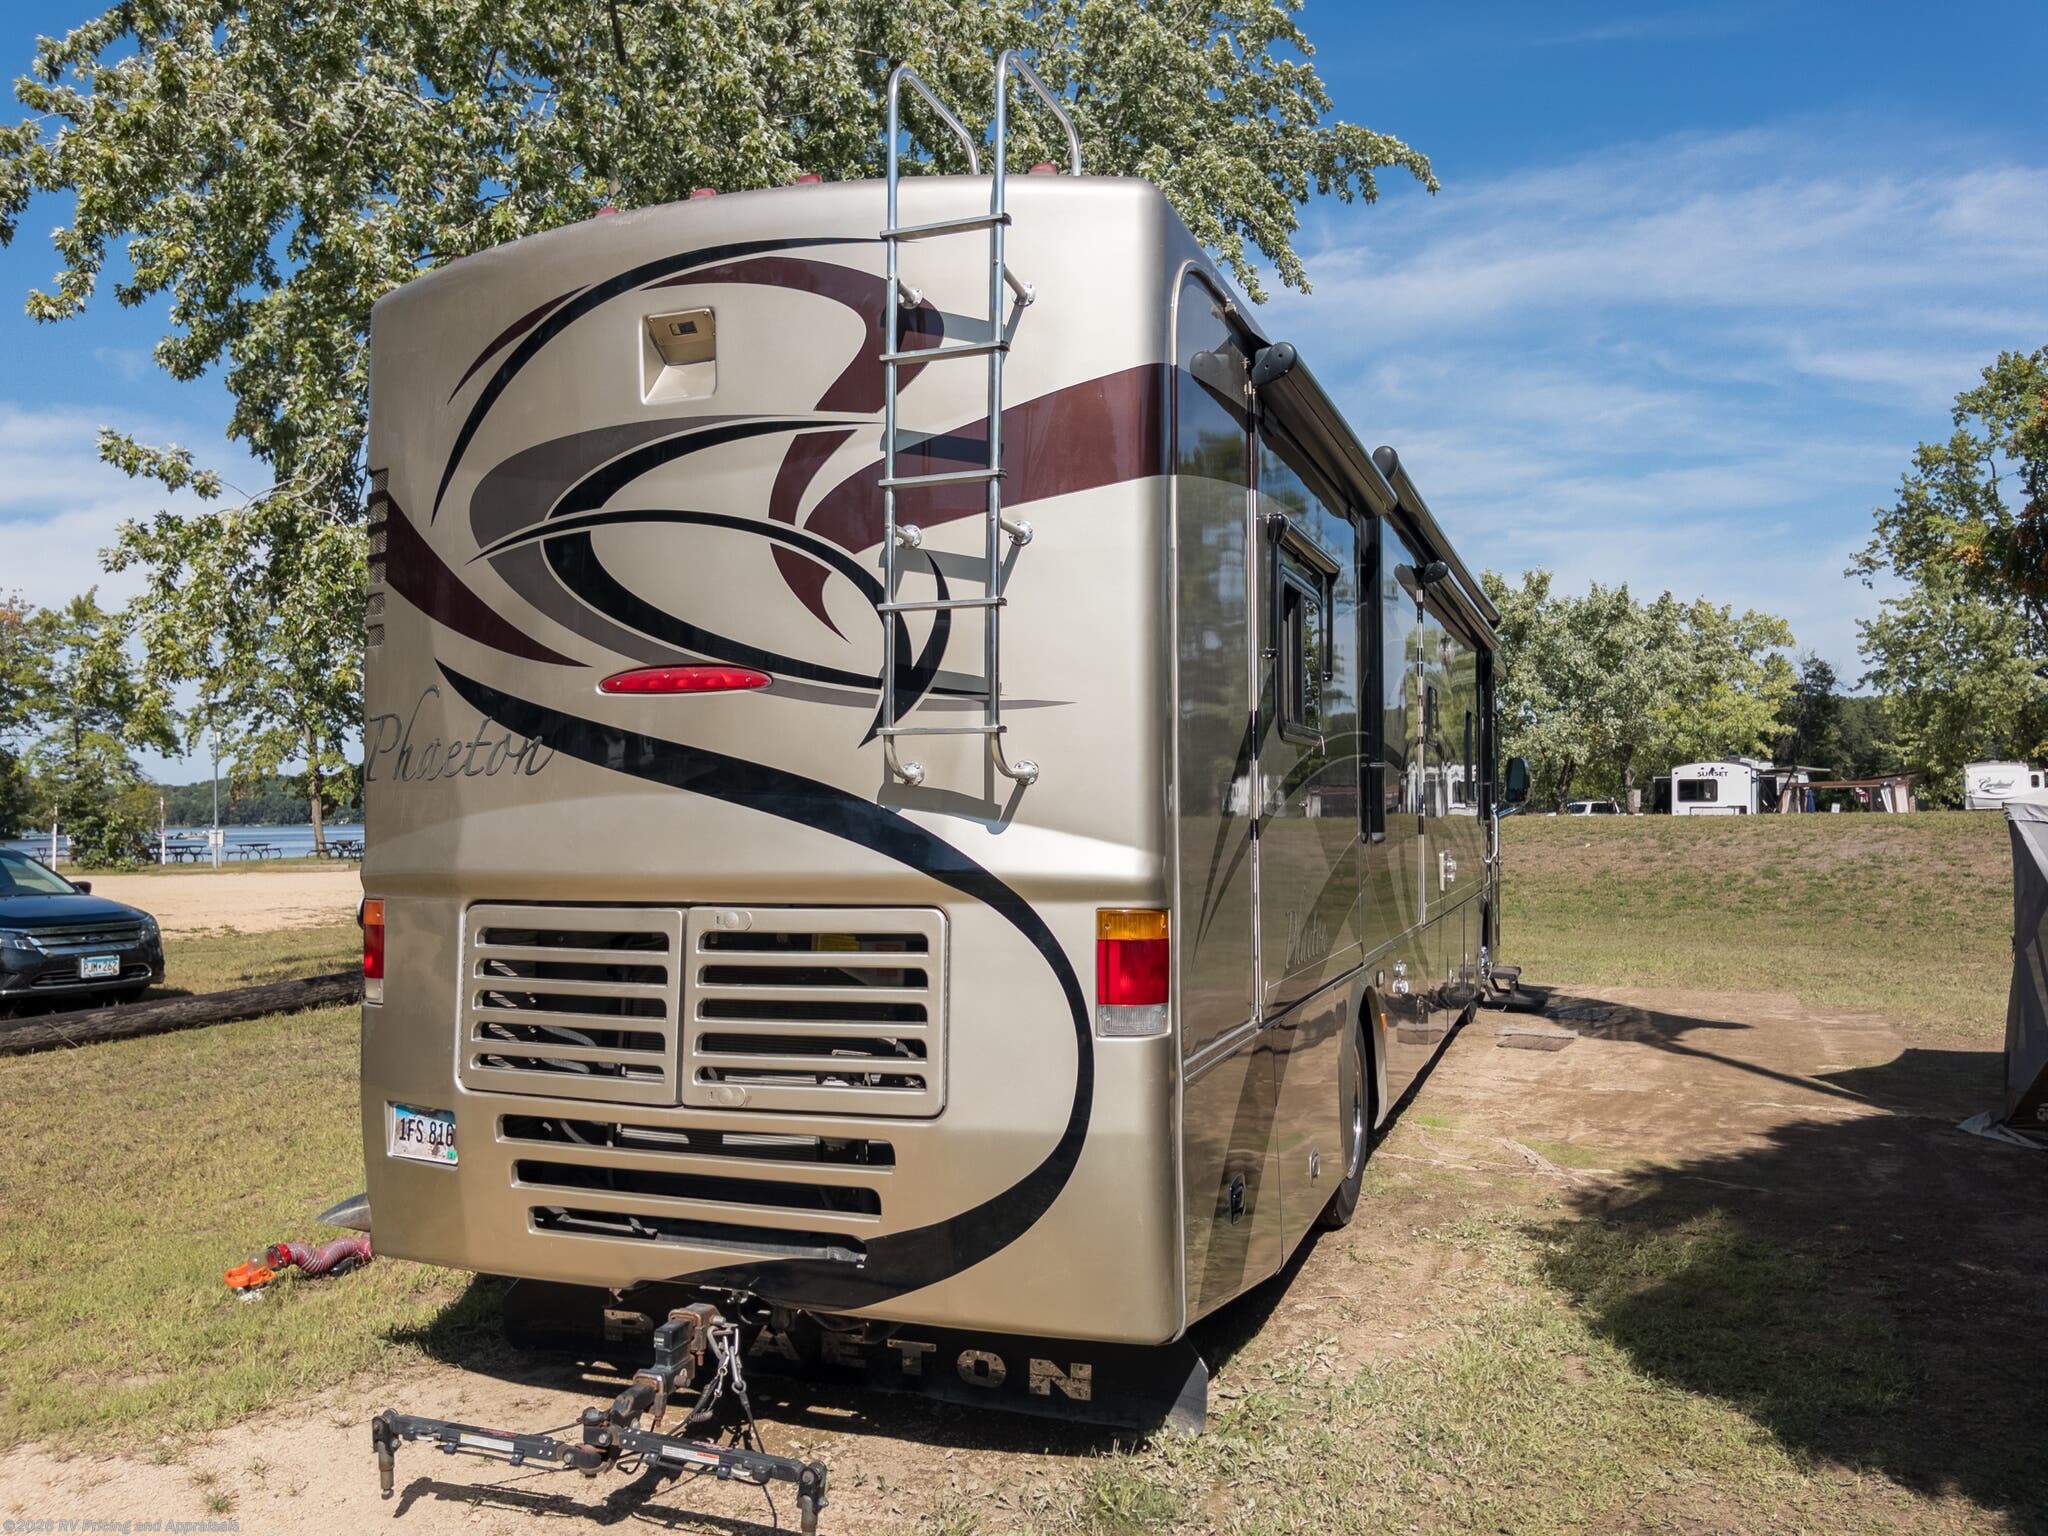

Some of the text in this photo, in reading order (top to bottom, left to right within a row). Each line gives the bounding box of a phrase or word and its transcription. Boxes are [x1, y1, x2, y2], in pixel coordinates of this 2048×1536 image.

[366, 684, 555, 782] Phaeton
[399, 1117, 454, 1147] 1FS 816
